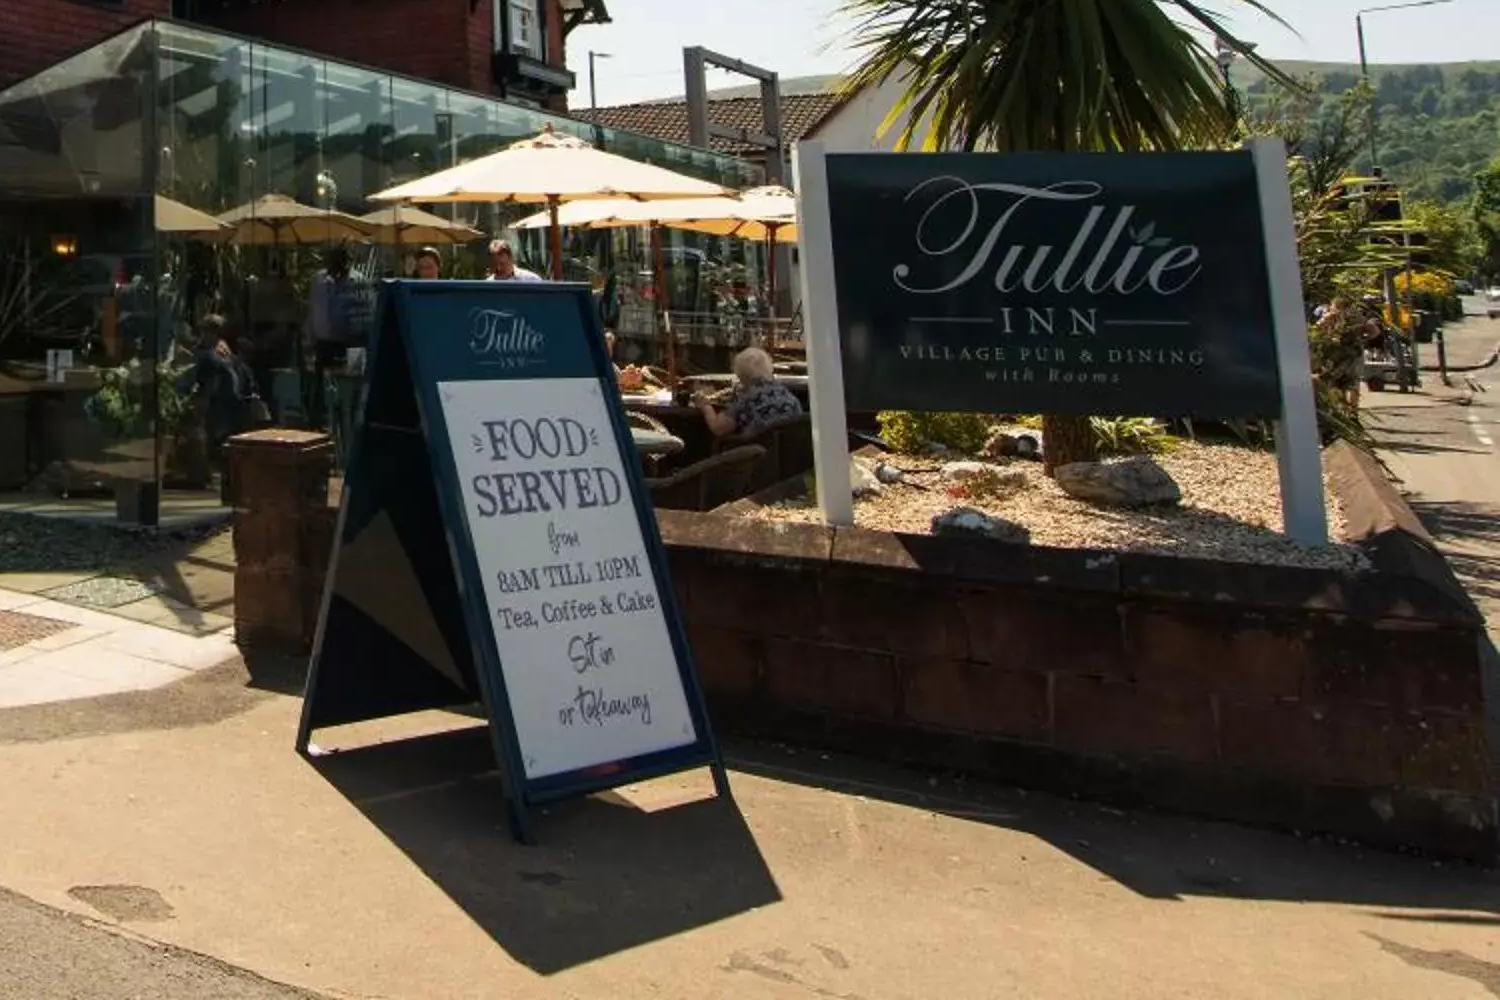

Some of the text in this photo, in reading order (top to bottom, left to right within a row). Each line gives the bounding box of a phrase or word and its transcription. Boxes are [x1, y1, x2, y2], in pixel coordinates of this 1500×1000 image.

[893, 175, 1202, 294] Tullie
[467, 305, 548, 353] Tullie
[1000, 307, 1098, 336] INN
[900, 346, 1204, 365] VILLAGE PUB & DINING
[984, 367, 1122, 384] with Rooms
[482, 417, 588, 461] FOOD
[473, 467, 622, 517] SERVED
[547, 521, 581, 554] from
[497, 555, 642, 593] 8AM TILL 10PM
[498, 590, 656, 630] Tea, Coffee & Cake
